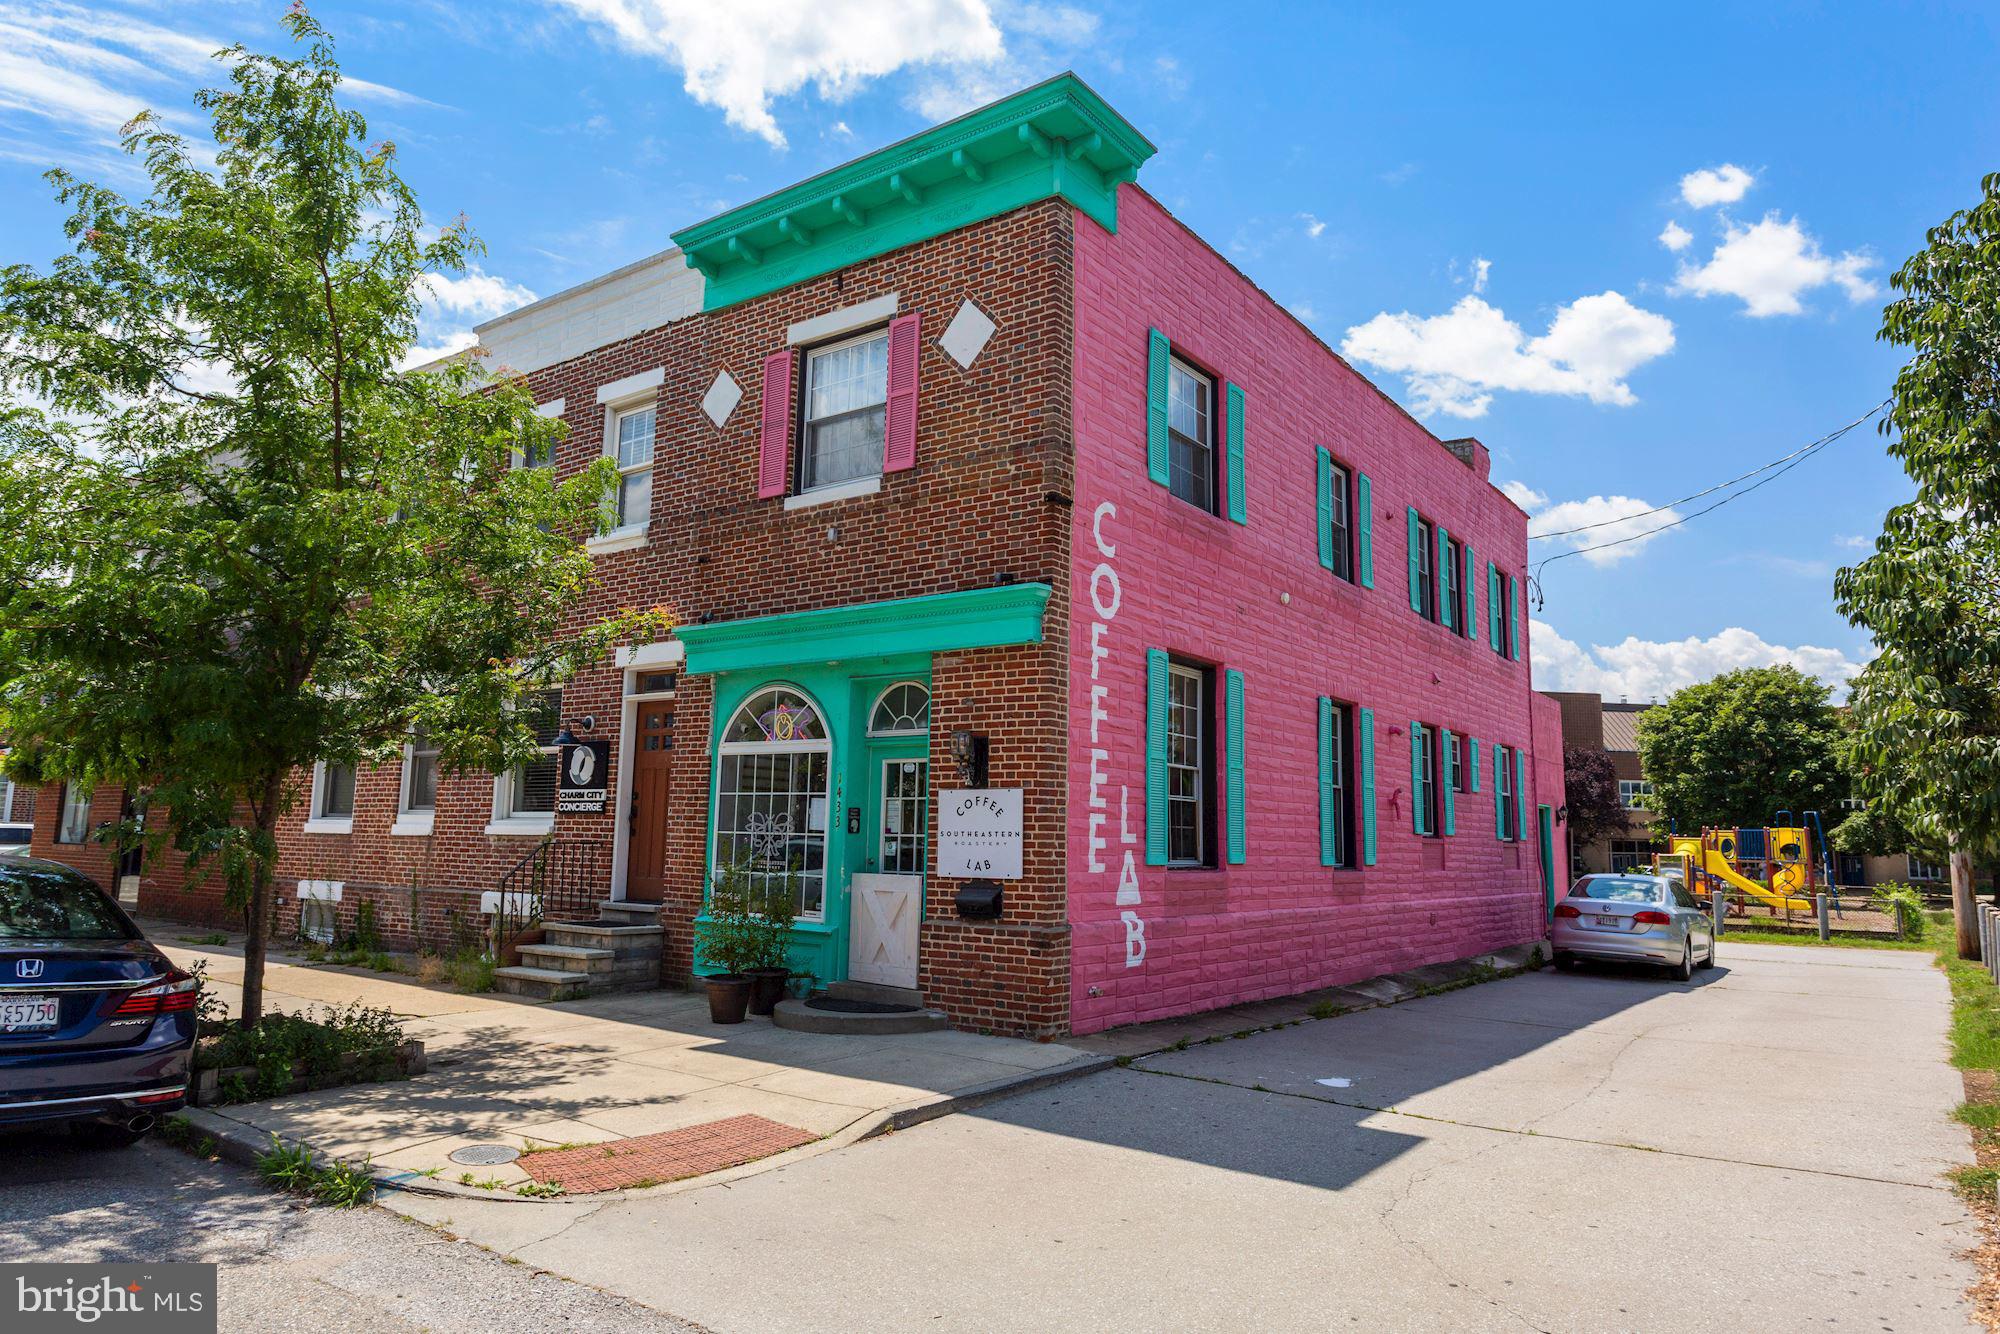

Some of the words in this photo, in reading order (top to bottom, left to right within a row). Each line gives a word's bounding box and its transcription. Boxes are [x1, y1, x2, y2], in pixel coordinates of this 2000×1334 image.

[1088, 502, 1121, 873] COFFEE
[560, 791, 585, 799] CHARM
[586, 791, 603, 799] CITY
[559, 802, 603, 811] CONCIERGE
[956, 796, 1004, 818] COFFEE
[966, 859, 991, 871] LAB
[1115, 785, 1147, 967] LAB
